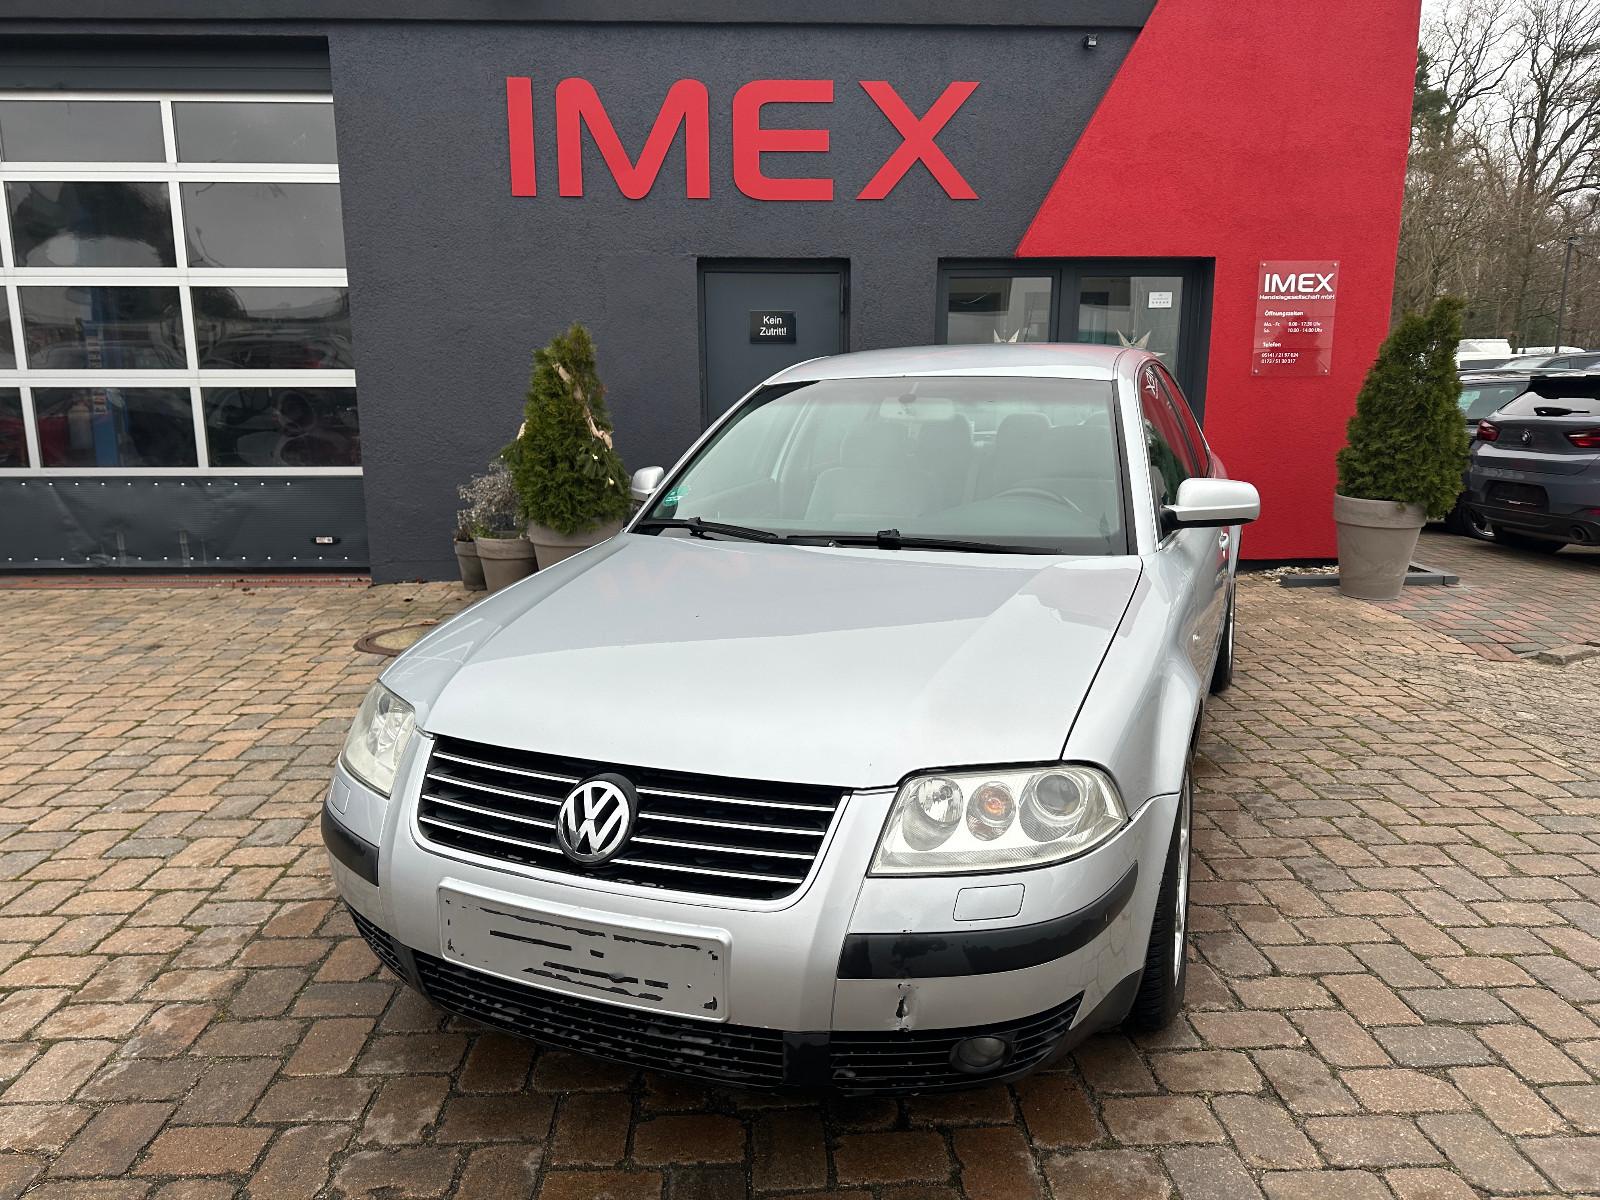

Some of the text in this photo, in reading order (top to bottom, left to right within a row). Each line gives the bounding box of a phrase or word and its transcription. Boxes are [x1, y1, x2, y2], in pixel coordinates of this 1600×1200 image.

[506, 76, 980, 202] IMEX
[1264, 273, 1335, 293] IMEX
[763, 315, 783, 325] Kein
[759, 326, 787, 336] Zutritt!
[557, 780, 630, 862] VW
